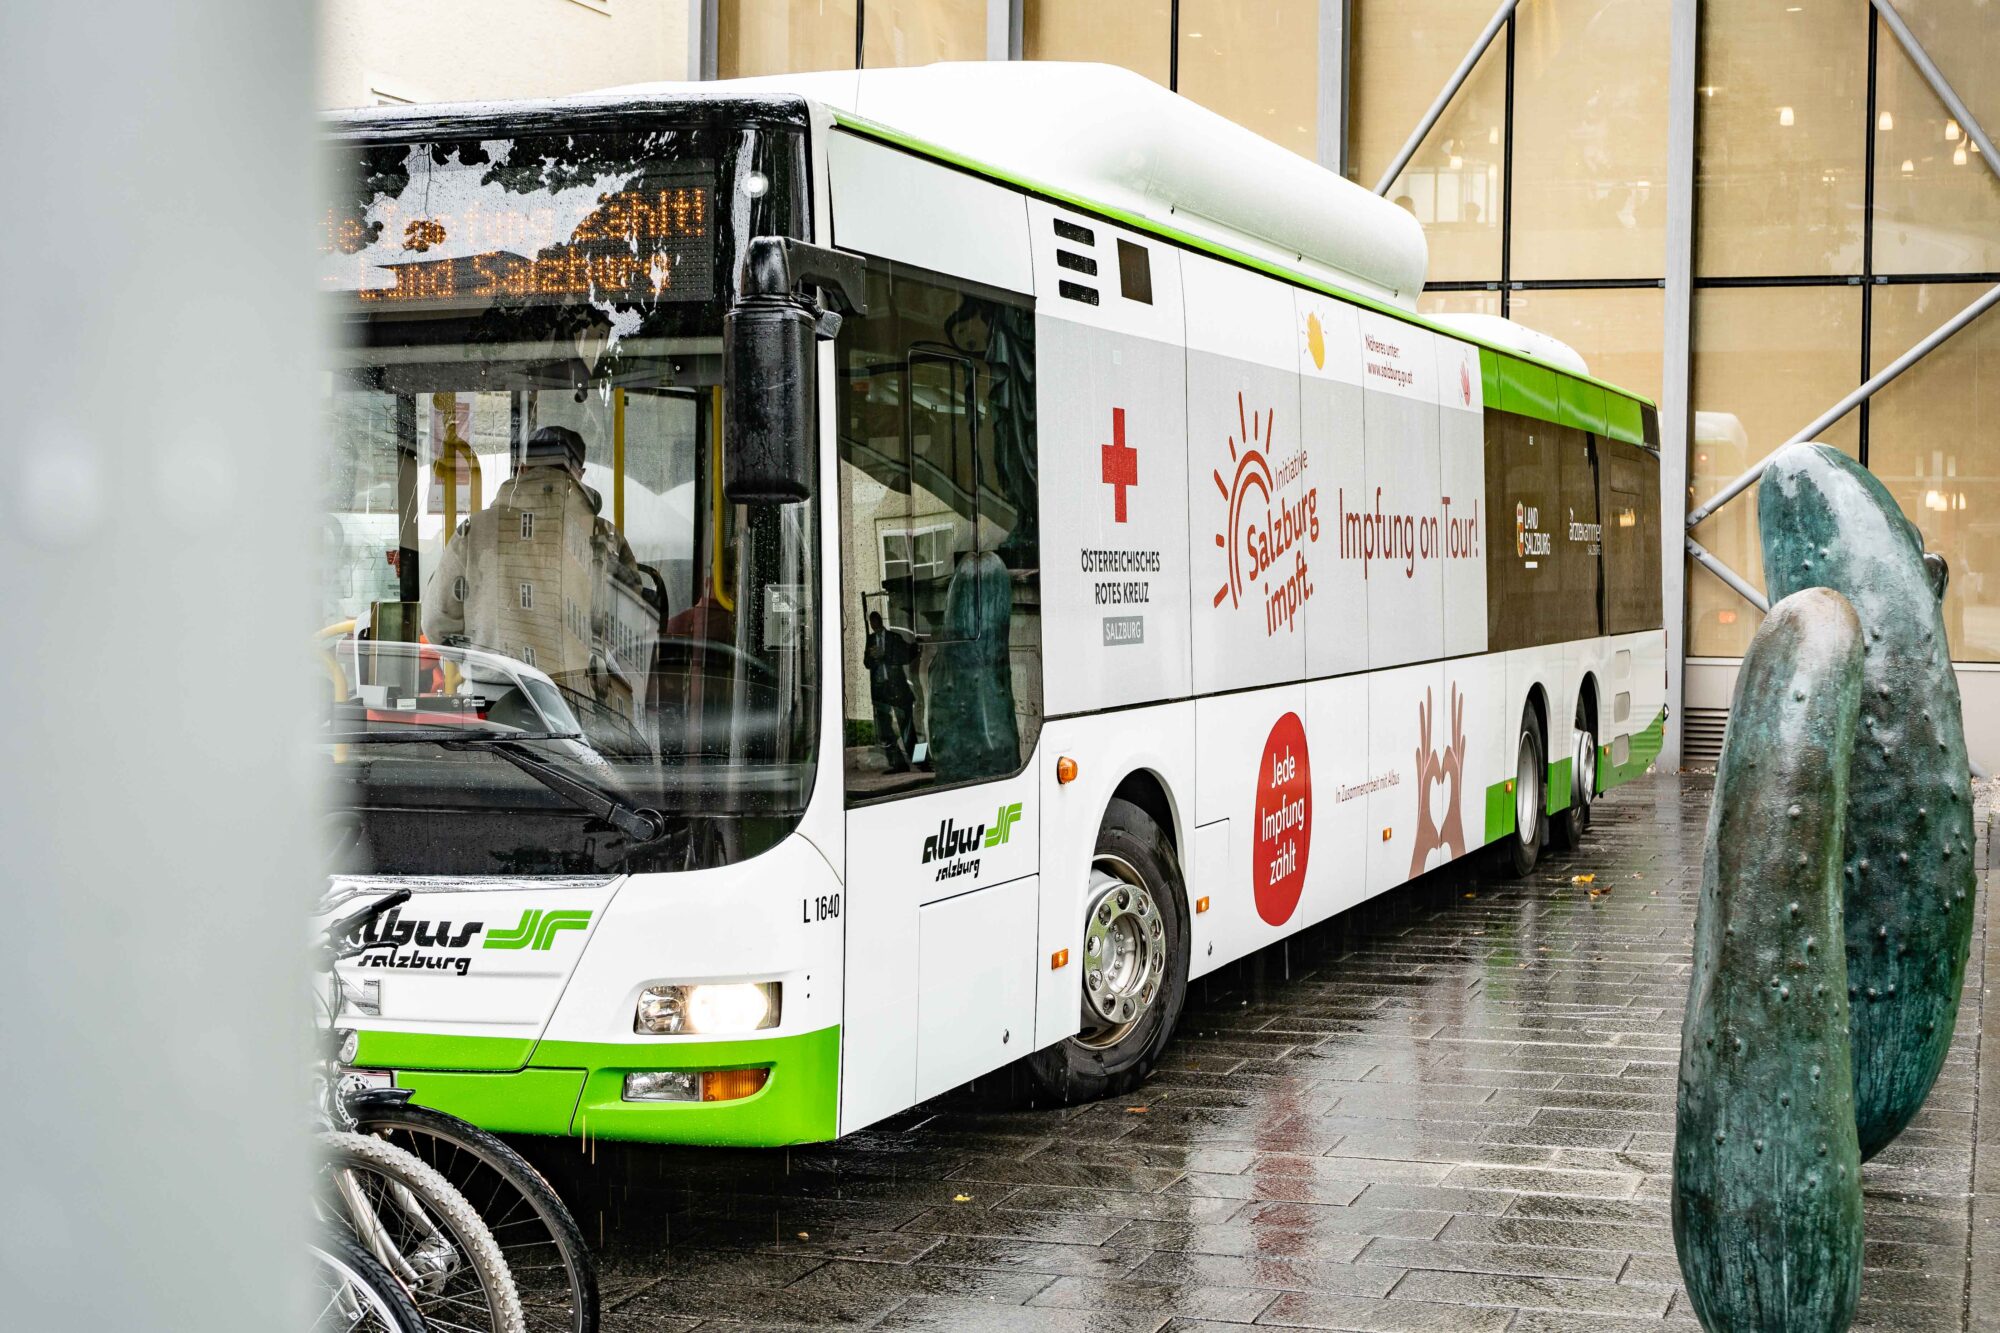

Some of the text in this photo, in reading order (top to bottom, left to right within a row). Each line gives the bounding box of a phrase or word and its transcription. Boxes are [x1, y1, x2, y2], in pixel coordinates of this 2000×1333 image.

[1364, 333, 1386, 355] Näheres
[1275, 449, 1308, 492] Initiative
[1339, 486, 1479, 580] Impfung on Tour!
[1524, 506, 1539, 530] LAND
[1247, 487, 1320, 582] Salzburg
[1524, 532, 1551, 556] SALZBURG
[1081, 548, 1161, 573] ÖSTERREICHISCHES
[1095, 581, 1150, 605] ROTES KREUZ
[1264, 549, 1314, 638] impft.
[1105, 621, 1142, 641] SALZBURG
[1271, 745, 1296, 789] Jede
[1262, 795, 1305, 845] Impfung
[922, 818, 985, 864] albus
[935, 858, 981, 882] salzburg
[1269, 838, 1297, 886] zählt
[803, 893, 841, 924] L 1640
[357, 949, 472, 977] salzburg
